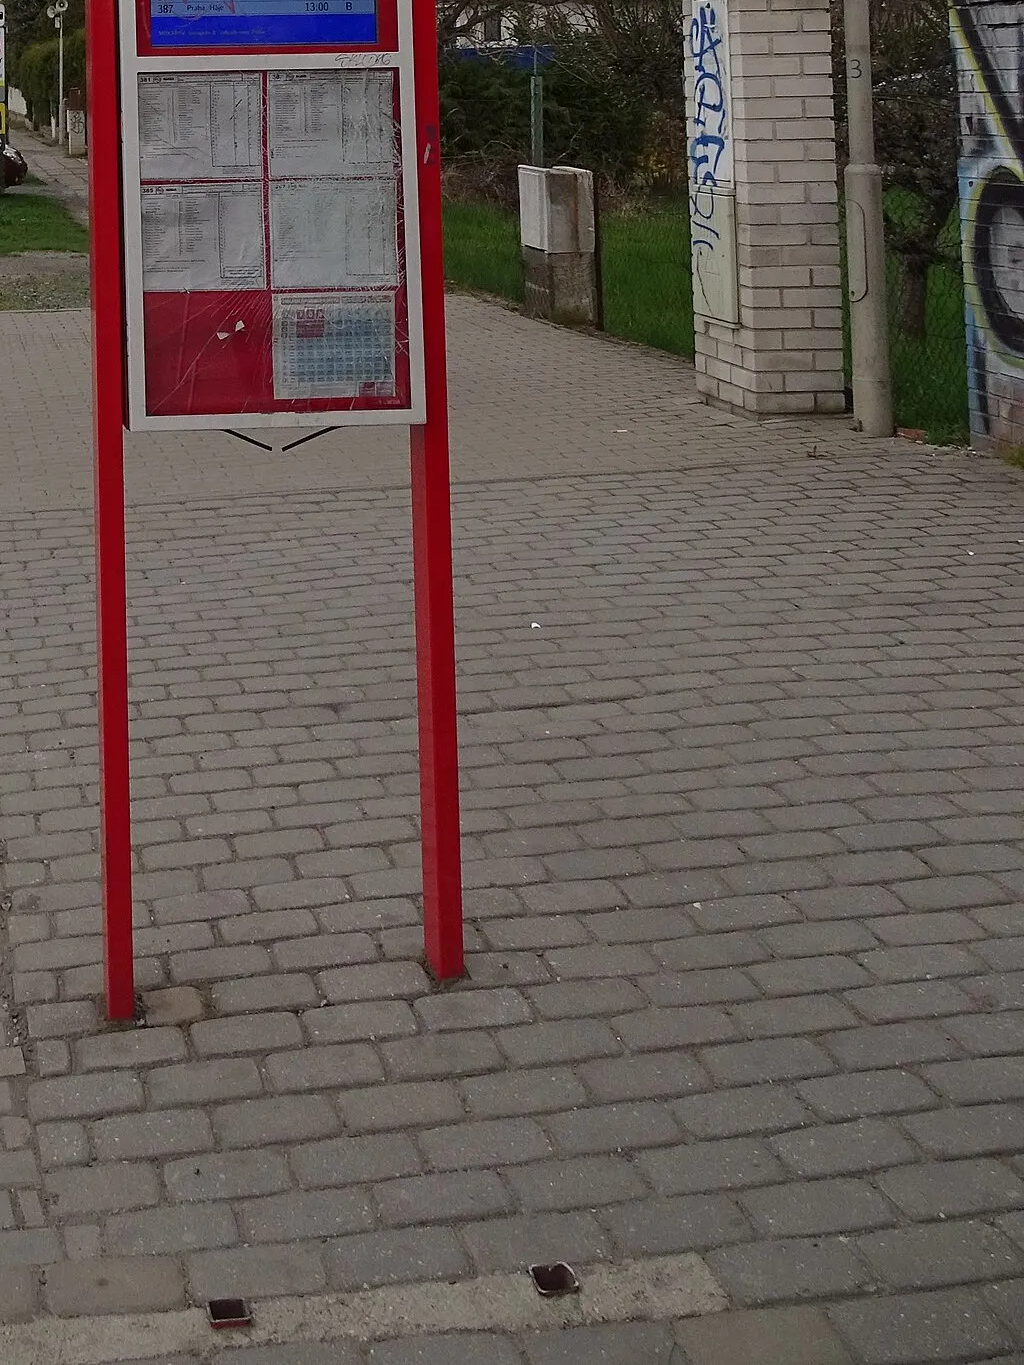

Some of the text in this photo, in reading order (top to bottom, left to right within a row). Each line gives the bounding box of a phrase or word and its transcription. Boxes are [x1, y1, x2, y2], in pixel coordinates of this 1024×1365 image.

[158, 4, 173, 14] 387
[305, 2, 329, 11] 13:00
[346, 2, 352, 10] B
[849, 59, 863, 78] 3
